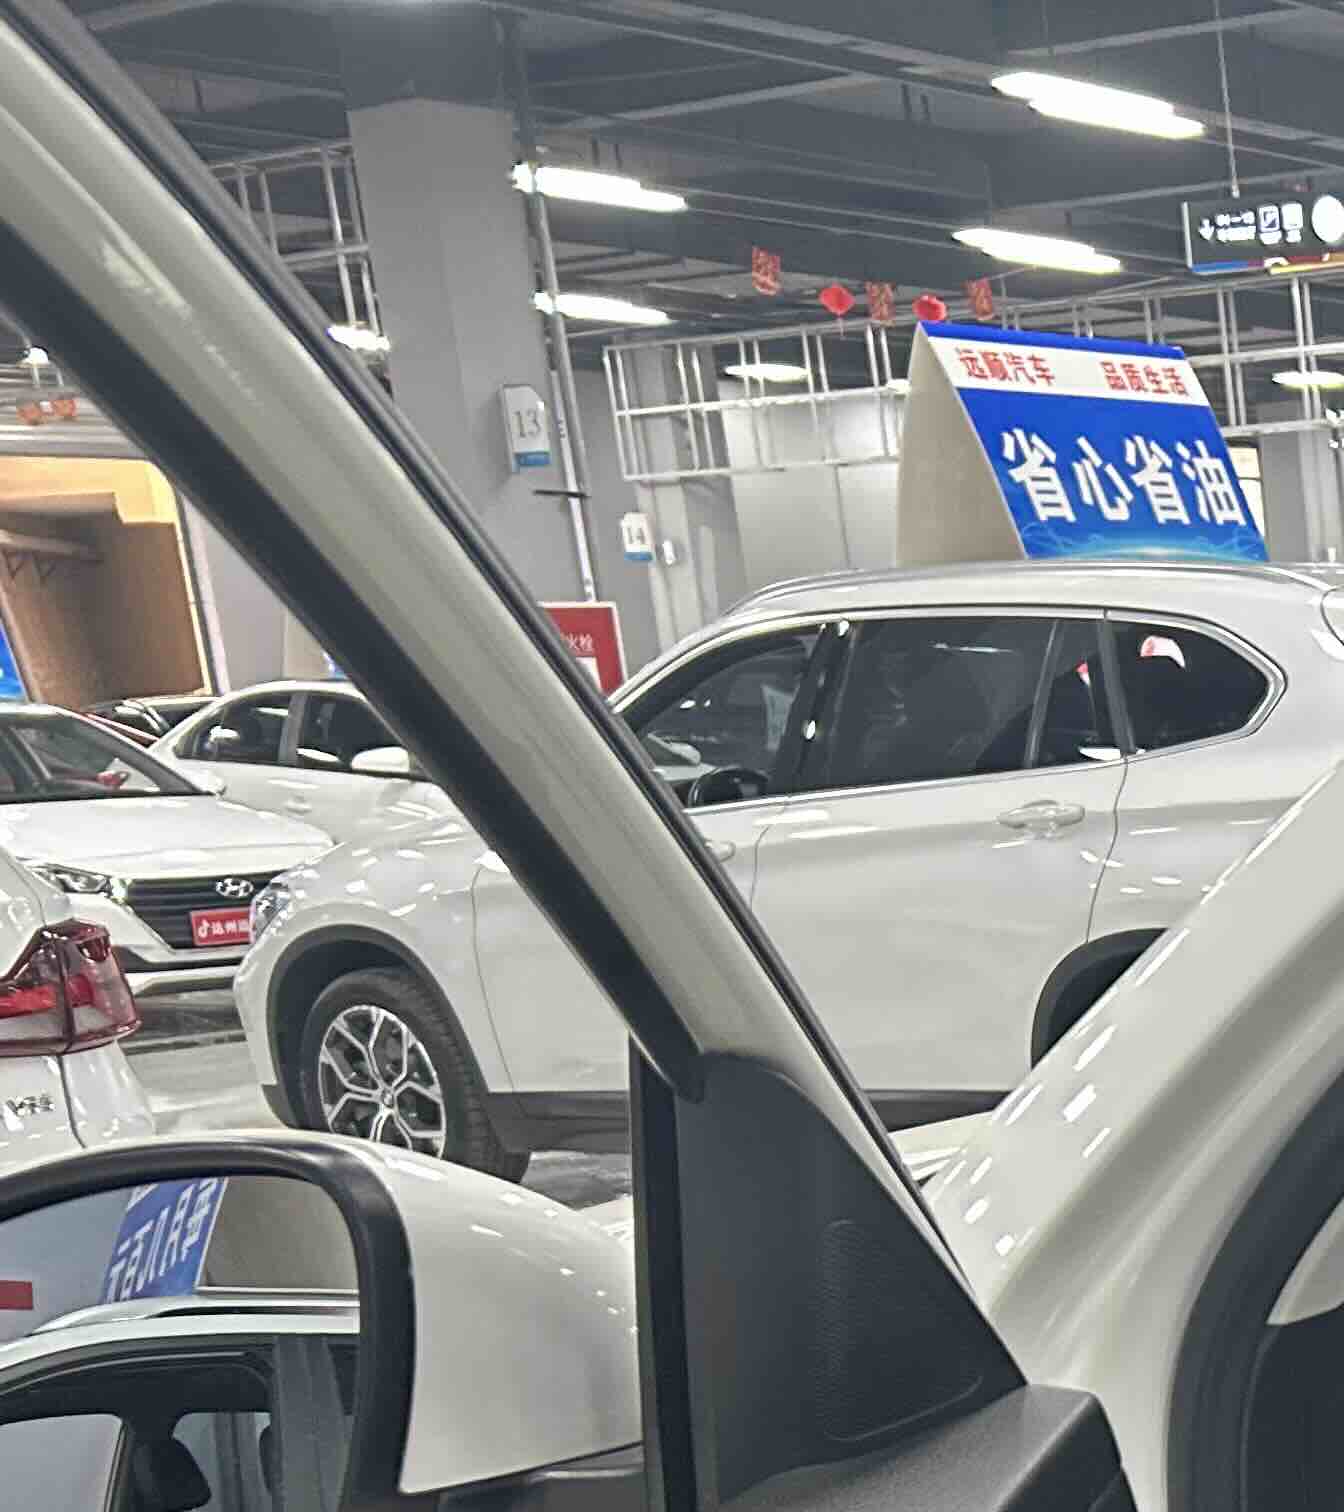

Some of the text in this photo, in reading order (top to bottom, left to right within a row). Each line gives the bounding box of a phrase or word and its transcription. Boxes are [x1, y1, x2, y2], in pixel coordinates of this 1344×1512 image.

[957, 346, 1056, 387] 远顺汽车
[1099, 359, 1190, 397] 品质生活
[512, 408, 542, 439] 13
[1001, 426, 1247, 526] 省心省油
[626, 526, 647, 546] 14
